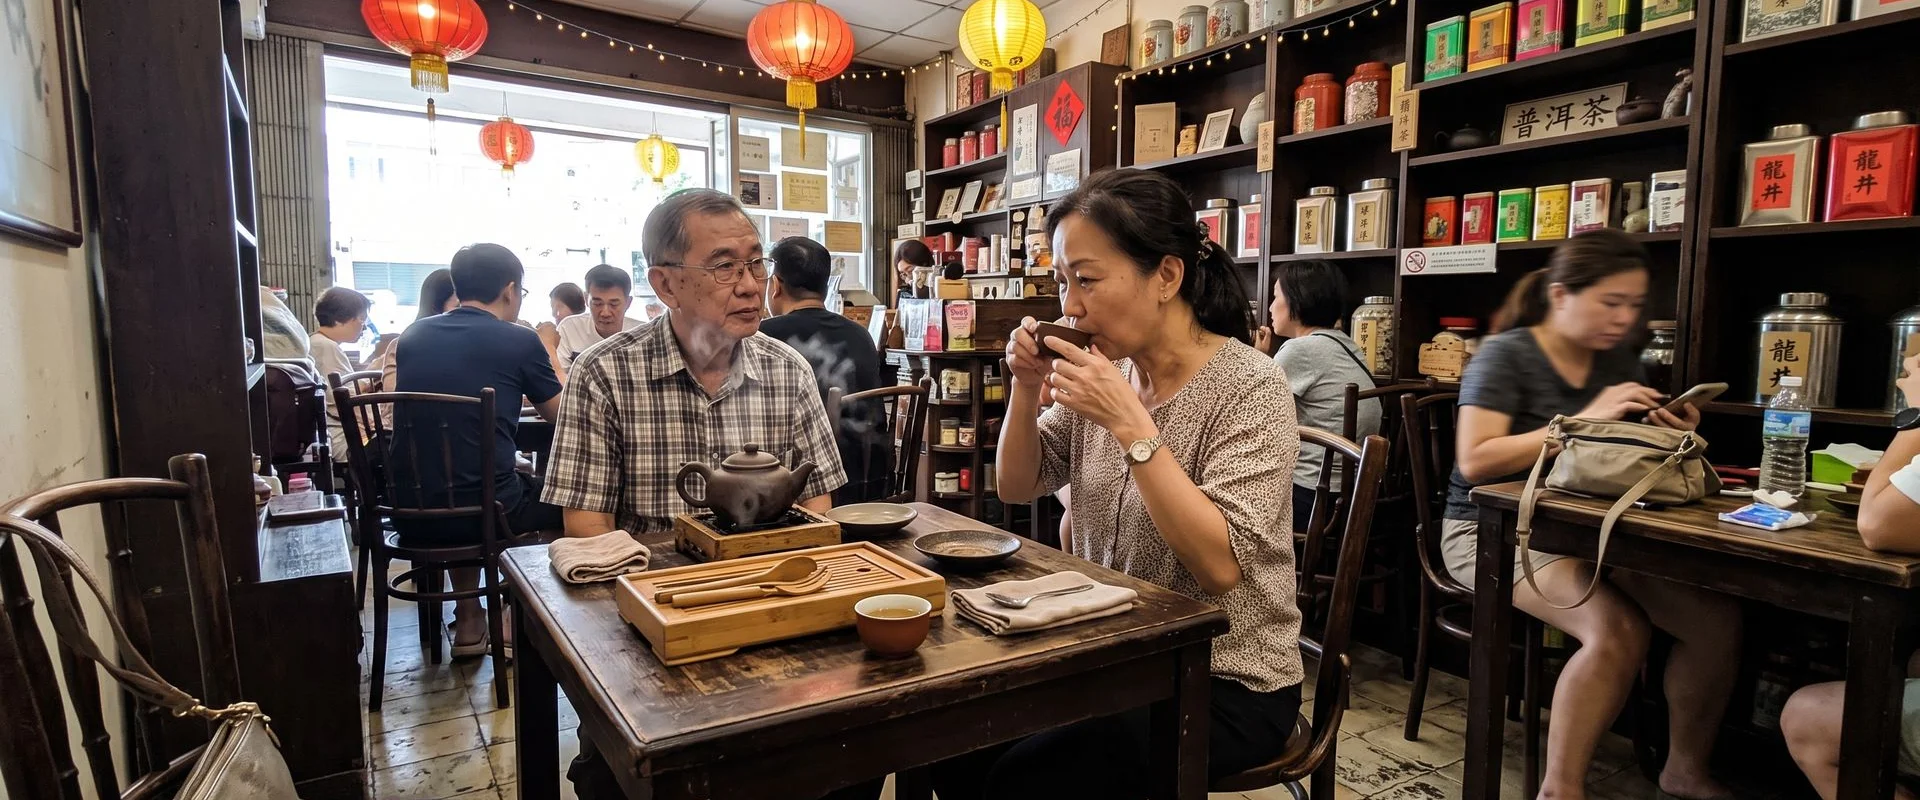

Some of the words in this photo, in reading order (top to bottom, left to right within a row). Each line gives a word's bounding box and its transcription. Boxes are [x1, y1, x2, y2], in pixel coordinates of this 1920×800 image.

[1053, 92, 1074, 132] 福
[1512, 94, 1614, 139] 普洱茶
[1761, 160, 1787, 203] 龍井
[1853, 149, 1883, 196] 龍井
